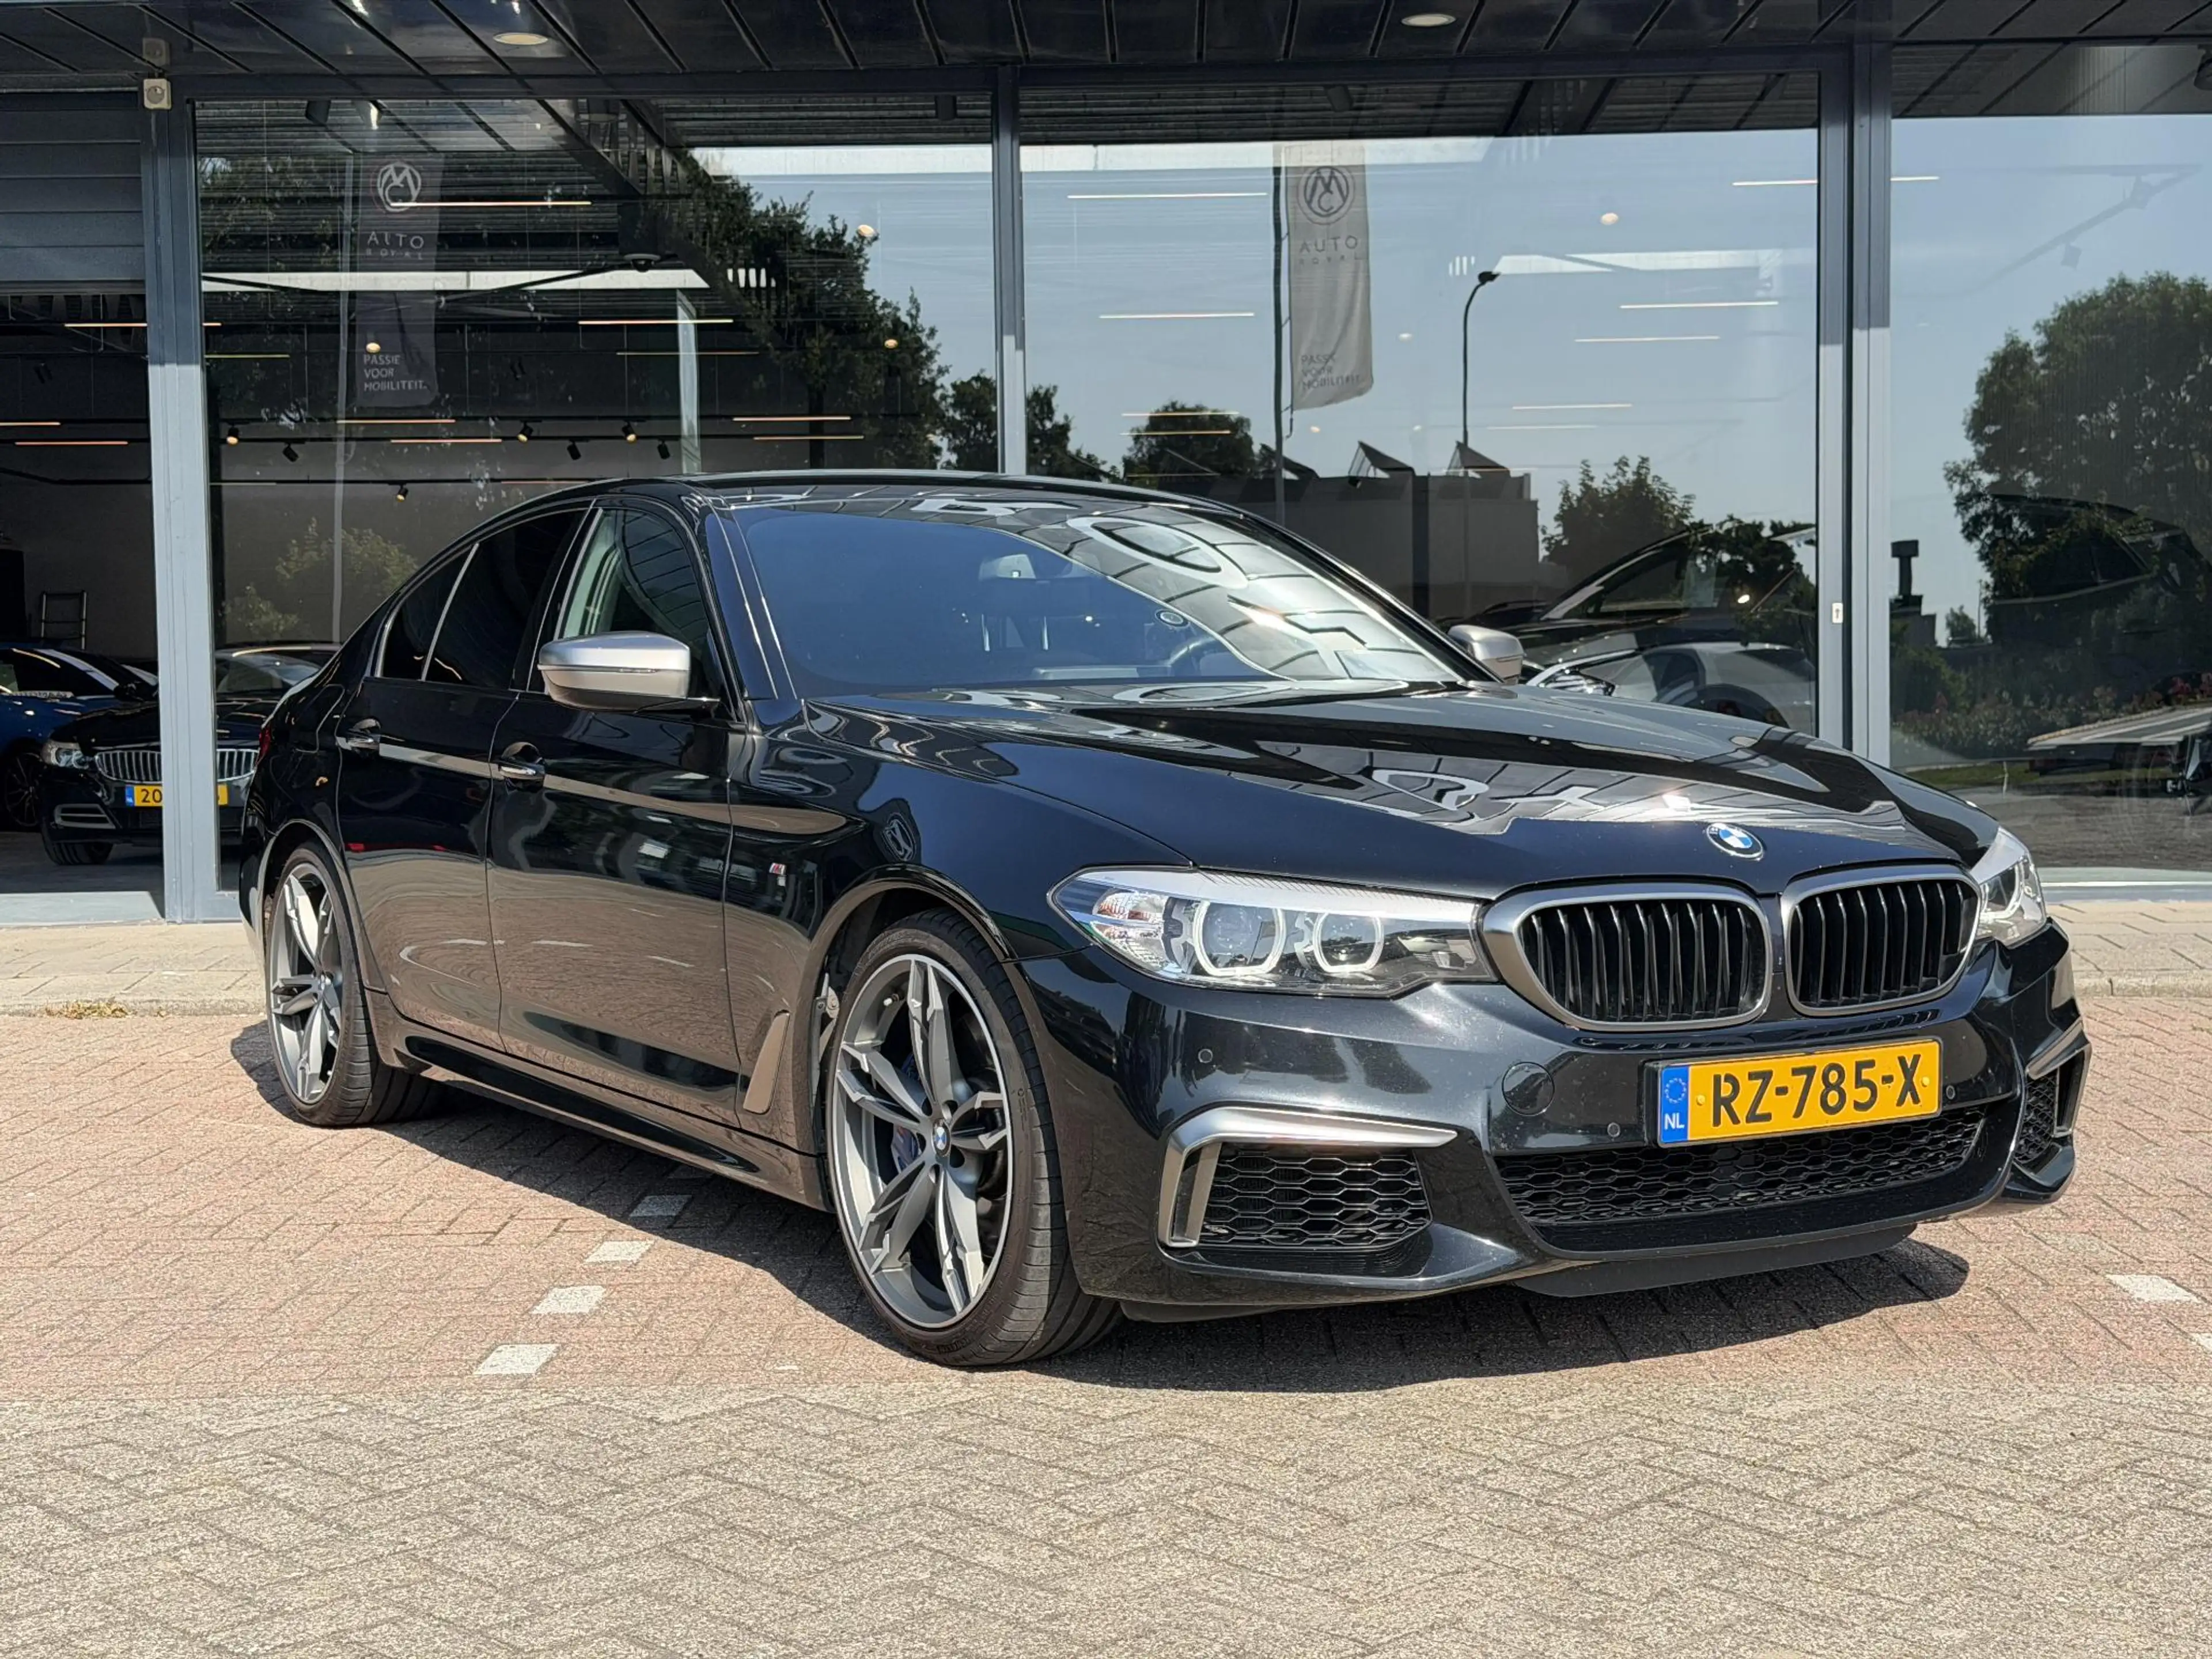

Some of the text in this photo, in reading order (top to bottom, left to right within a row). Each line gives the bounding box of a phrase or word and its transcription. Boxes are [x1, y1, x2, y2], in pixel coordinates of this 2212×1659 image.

[1300, 235, 1358, 253] AUTO
[363, 354, 401, 365] PASSIE
[363, 368, 395, 378] VOOR
[1712, 1054, 1922, 1127] RZ-785-X
[1664, 1112, 1685, 1130] NL
